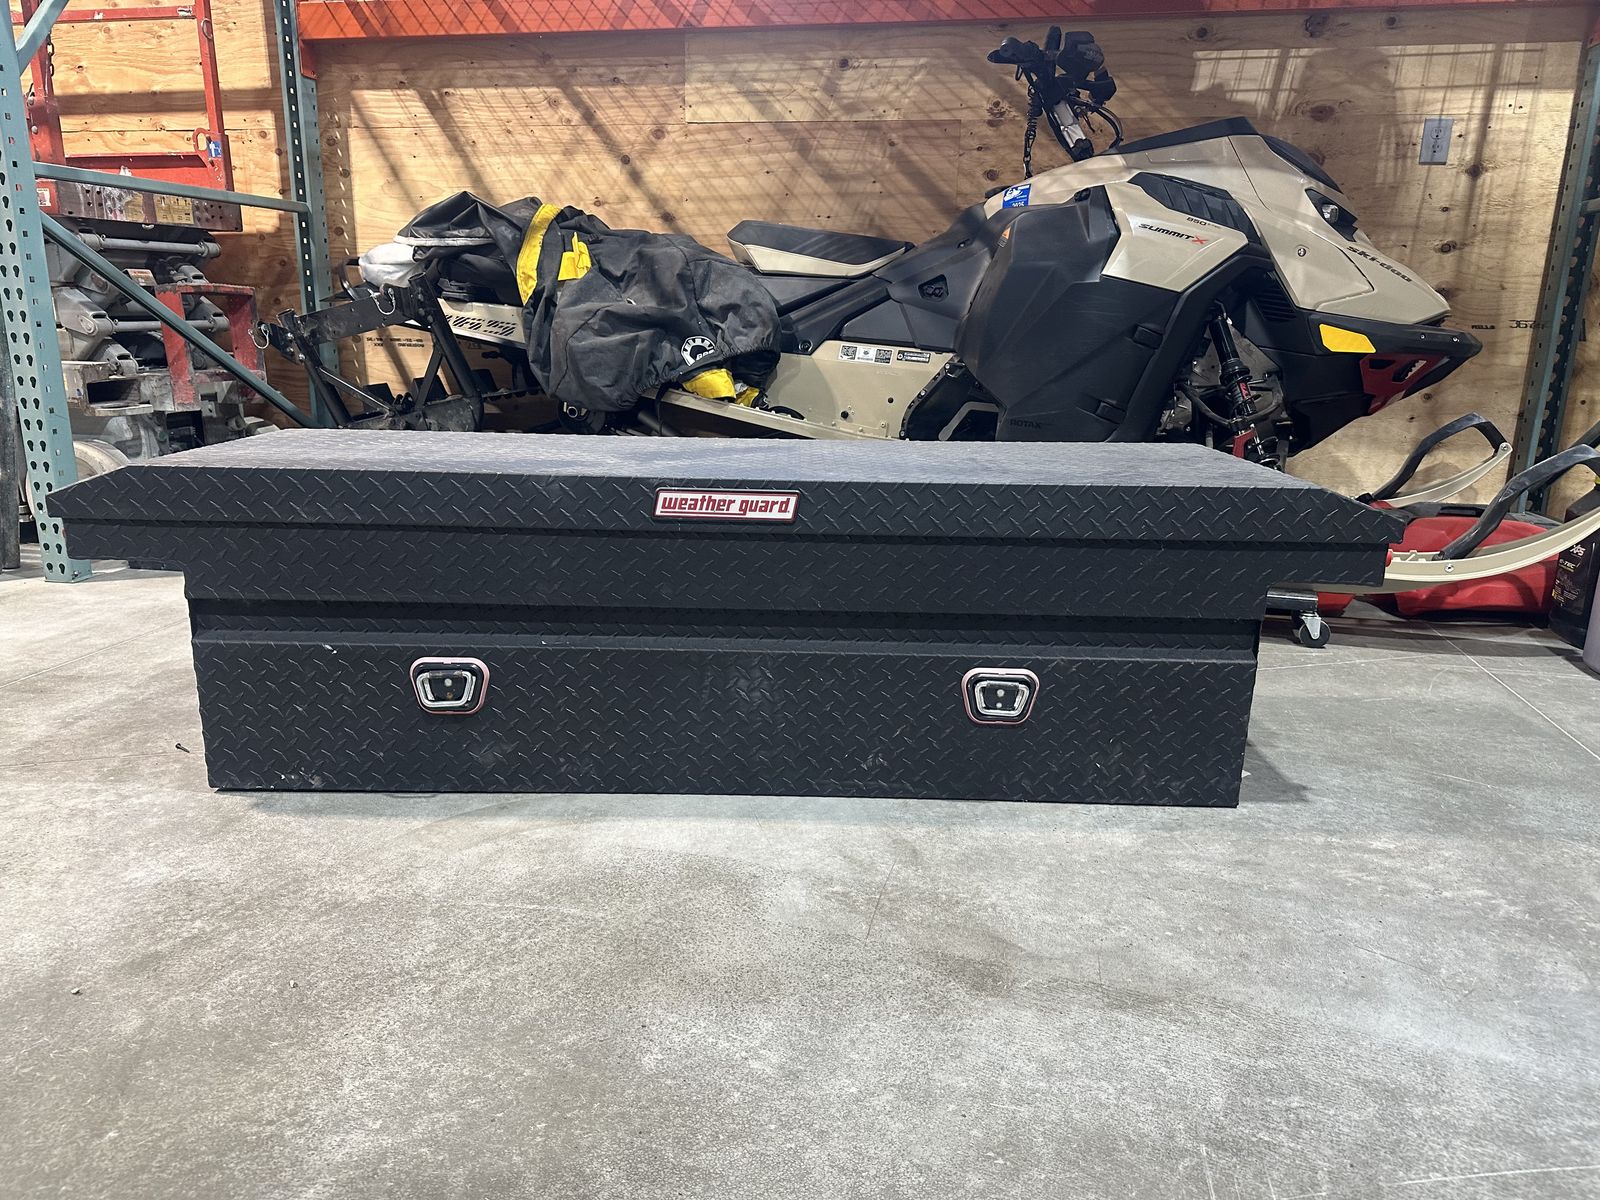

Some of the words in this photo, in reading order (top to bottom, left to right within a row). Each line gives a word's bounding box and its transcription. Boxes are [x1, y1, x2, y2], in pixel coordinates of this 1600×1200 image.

[1186, 216, 1207, 226] 850
[1138, 223, 1195, 240] SUMMIT
[661, 495, 736, 512] weather
[738, 497, 789, 516] guard
